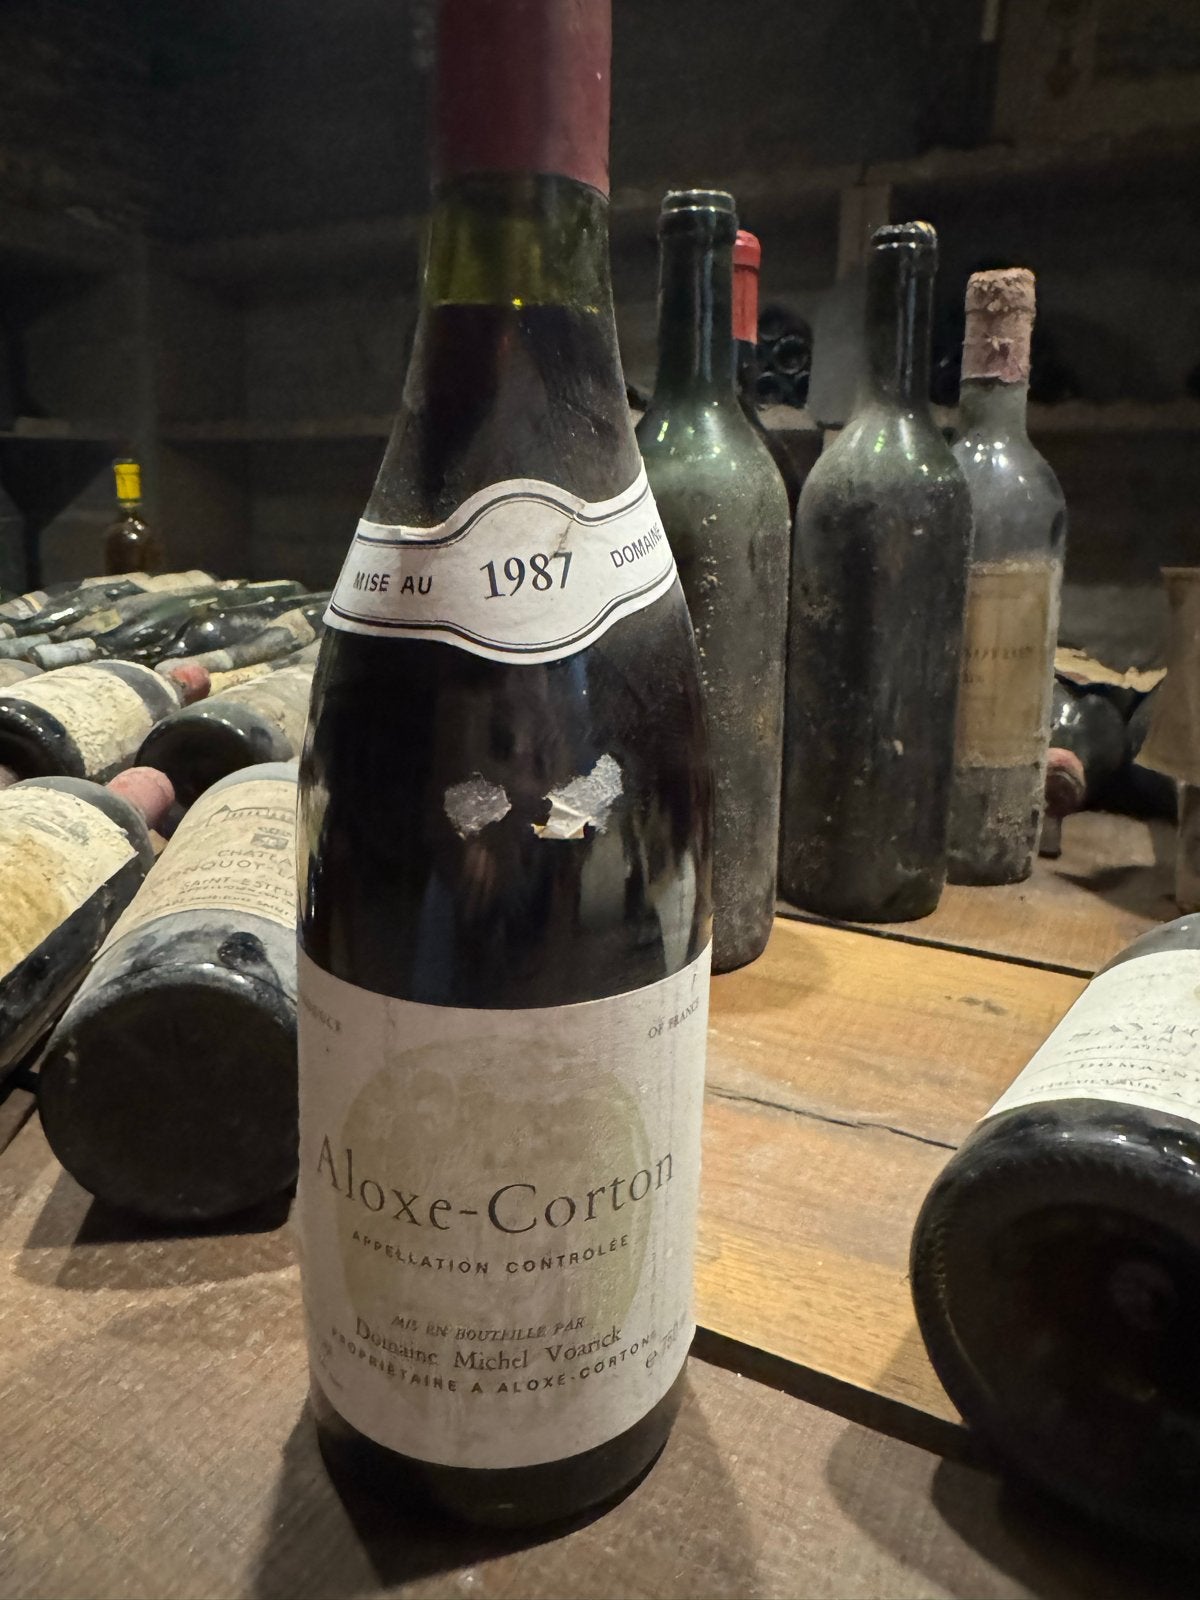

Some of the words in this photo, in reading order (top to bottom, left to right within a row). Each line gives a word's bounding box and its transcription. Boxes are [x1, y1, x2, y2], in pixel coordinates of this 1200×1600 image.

[610, 522, 662, 568] DOMAINE
[353, 571, 390, 592] MISE
[401, 575, 433, 595] AU
[480, 551, 572, 600] 1987
[648, 1023, 664, 1038] OF
[317, 1134, 673, 1234] Aloxe-Corton
[352, 1230, 488, 1274] APPELLATION
[356, 1316, 439, 1367] Domaine
[453, 1350, 528, 1372] Michel
[545, 1324, 622, 1362] Voarick
[391, 1316, 418, 1332] MIS
[426, 1321, 449, 1337] EN
[455, 1327, 546, 1342] BOUTEILLE
[553, 1316, 586, 1336] PAR
